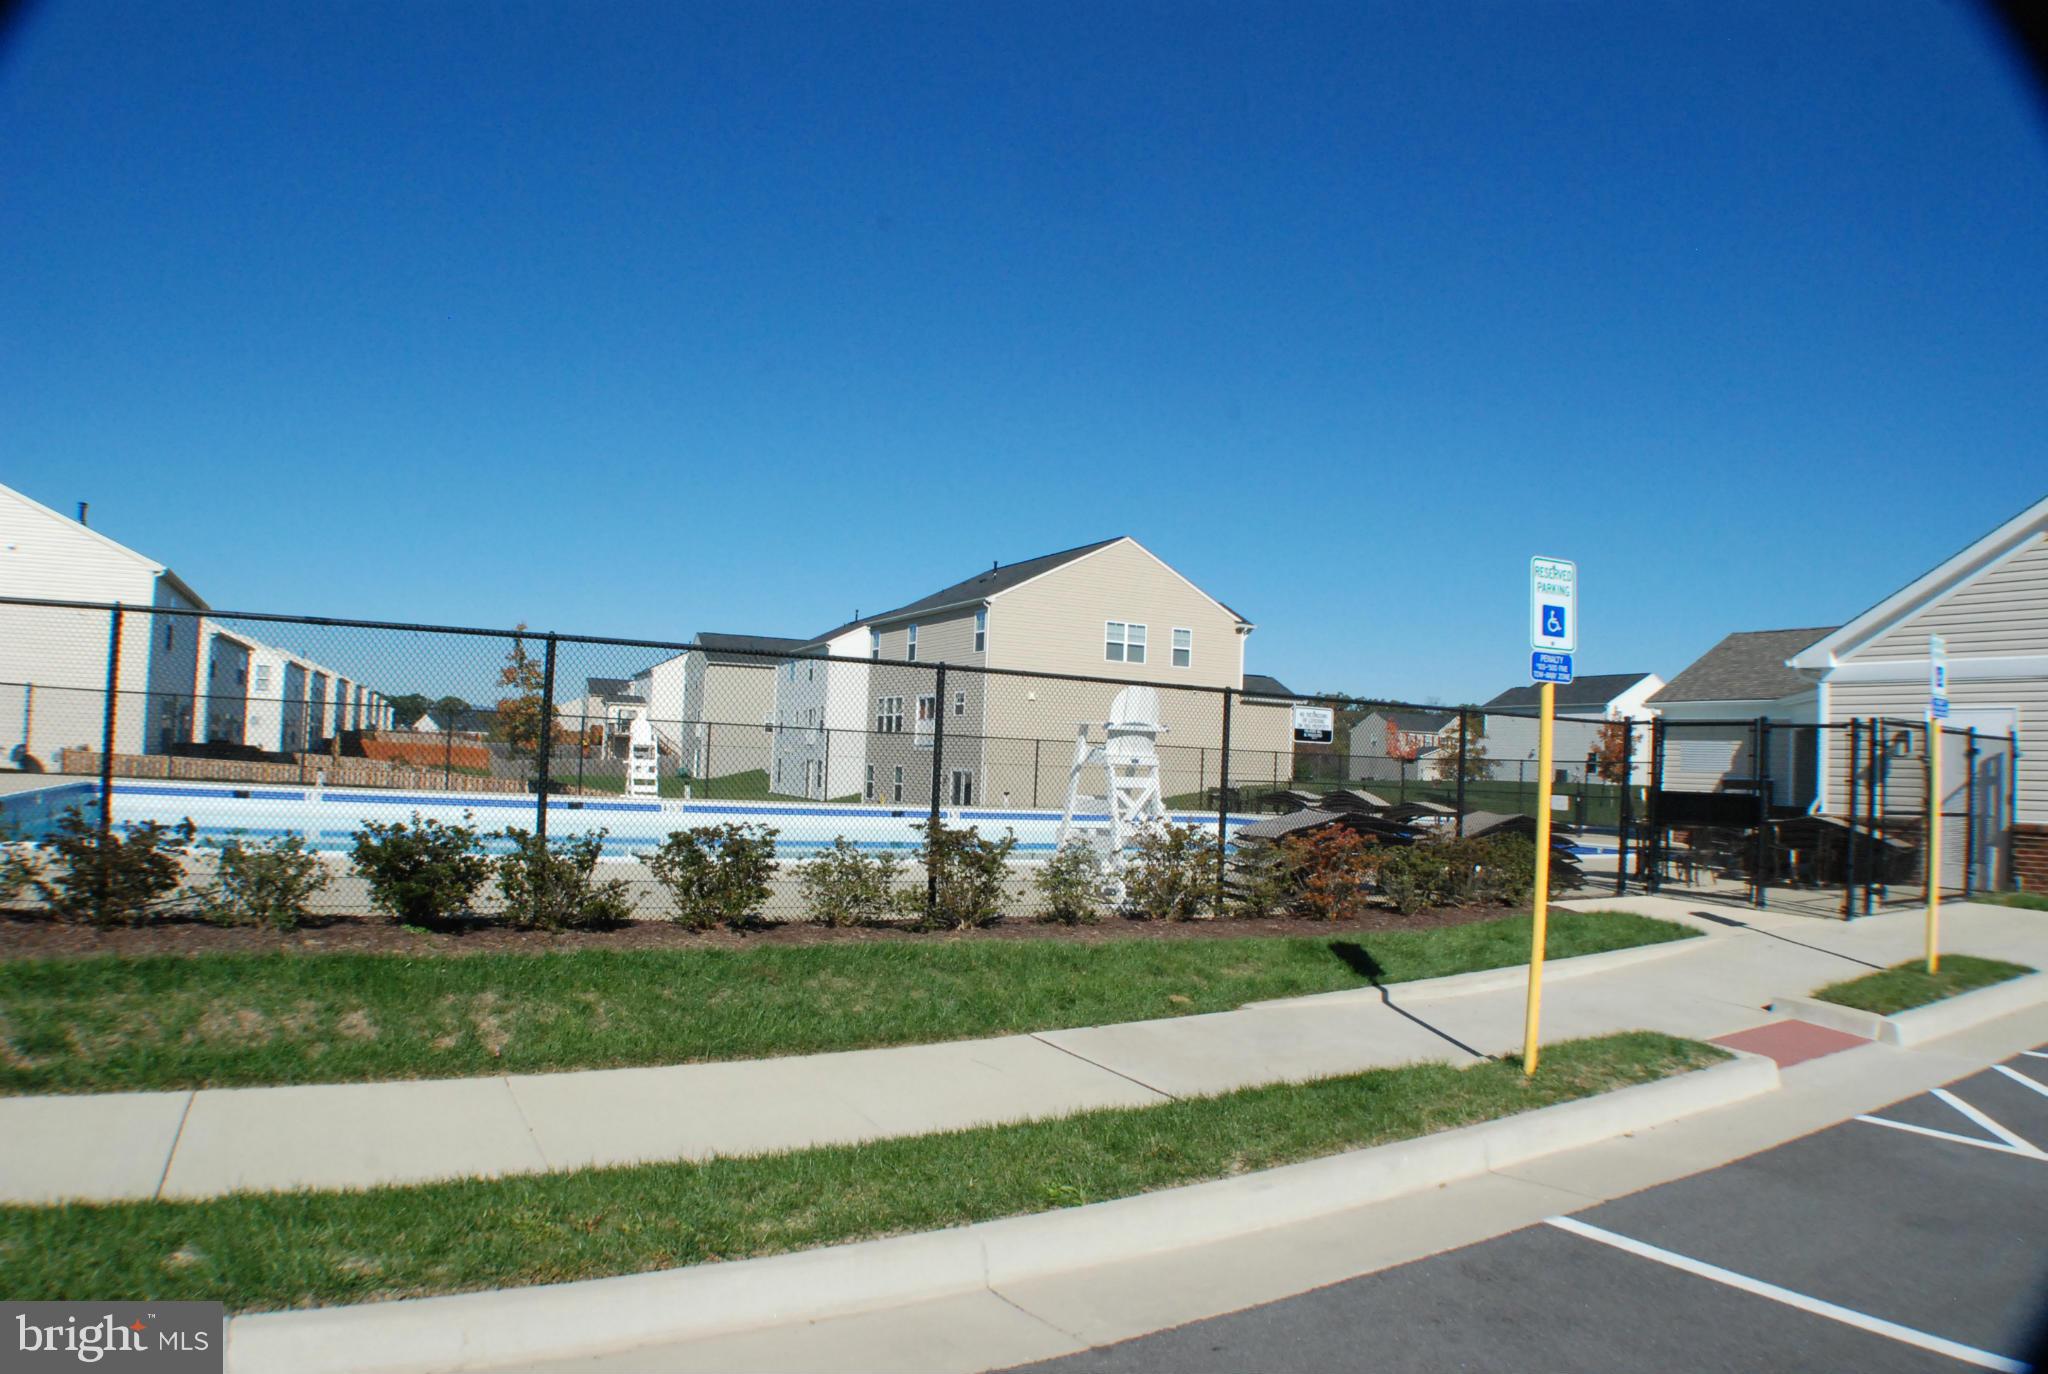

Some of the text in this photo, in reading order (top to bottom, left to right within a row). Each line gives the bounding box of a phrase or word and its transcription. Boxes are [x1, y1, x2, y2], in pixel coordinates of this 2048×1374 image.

[1535, 565, 1572, 582] RESERVED
[1537, 582, 1570, 597] PARKING
[1540, 654, 1564, 664] PENALTY
